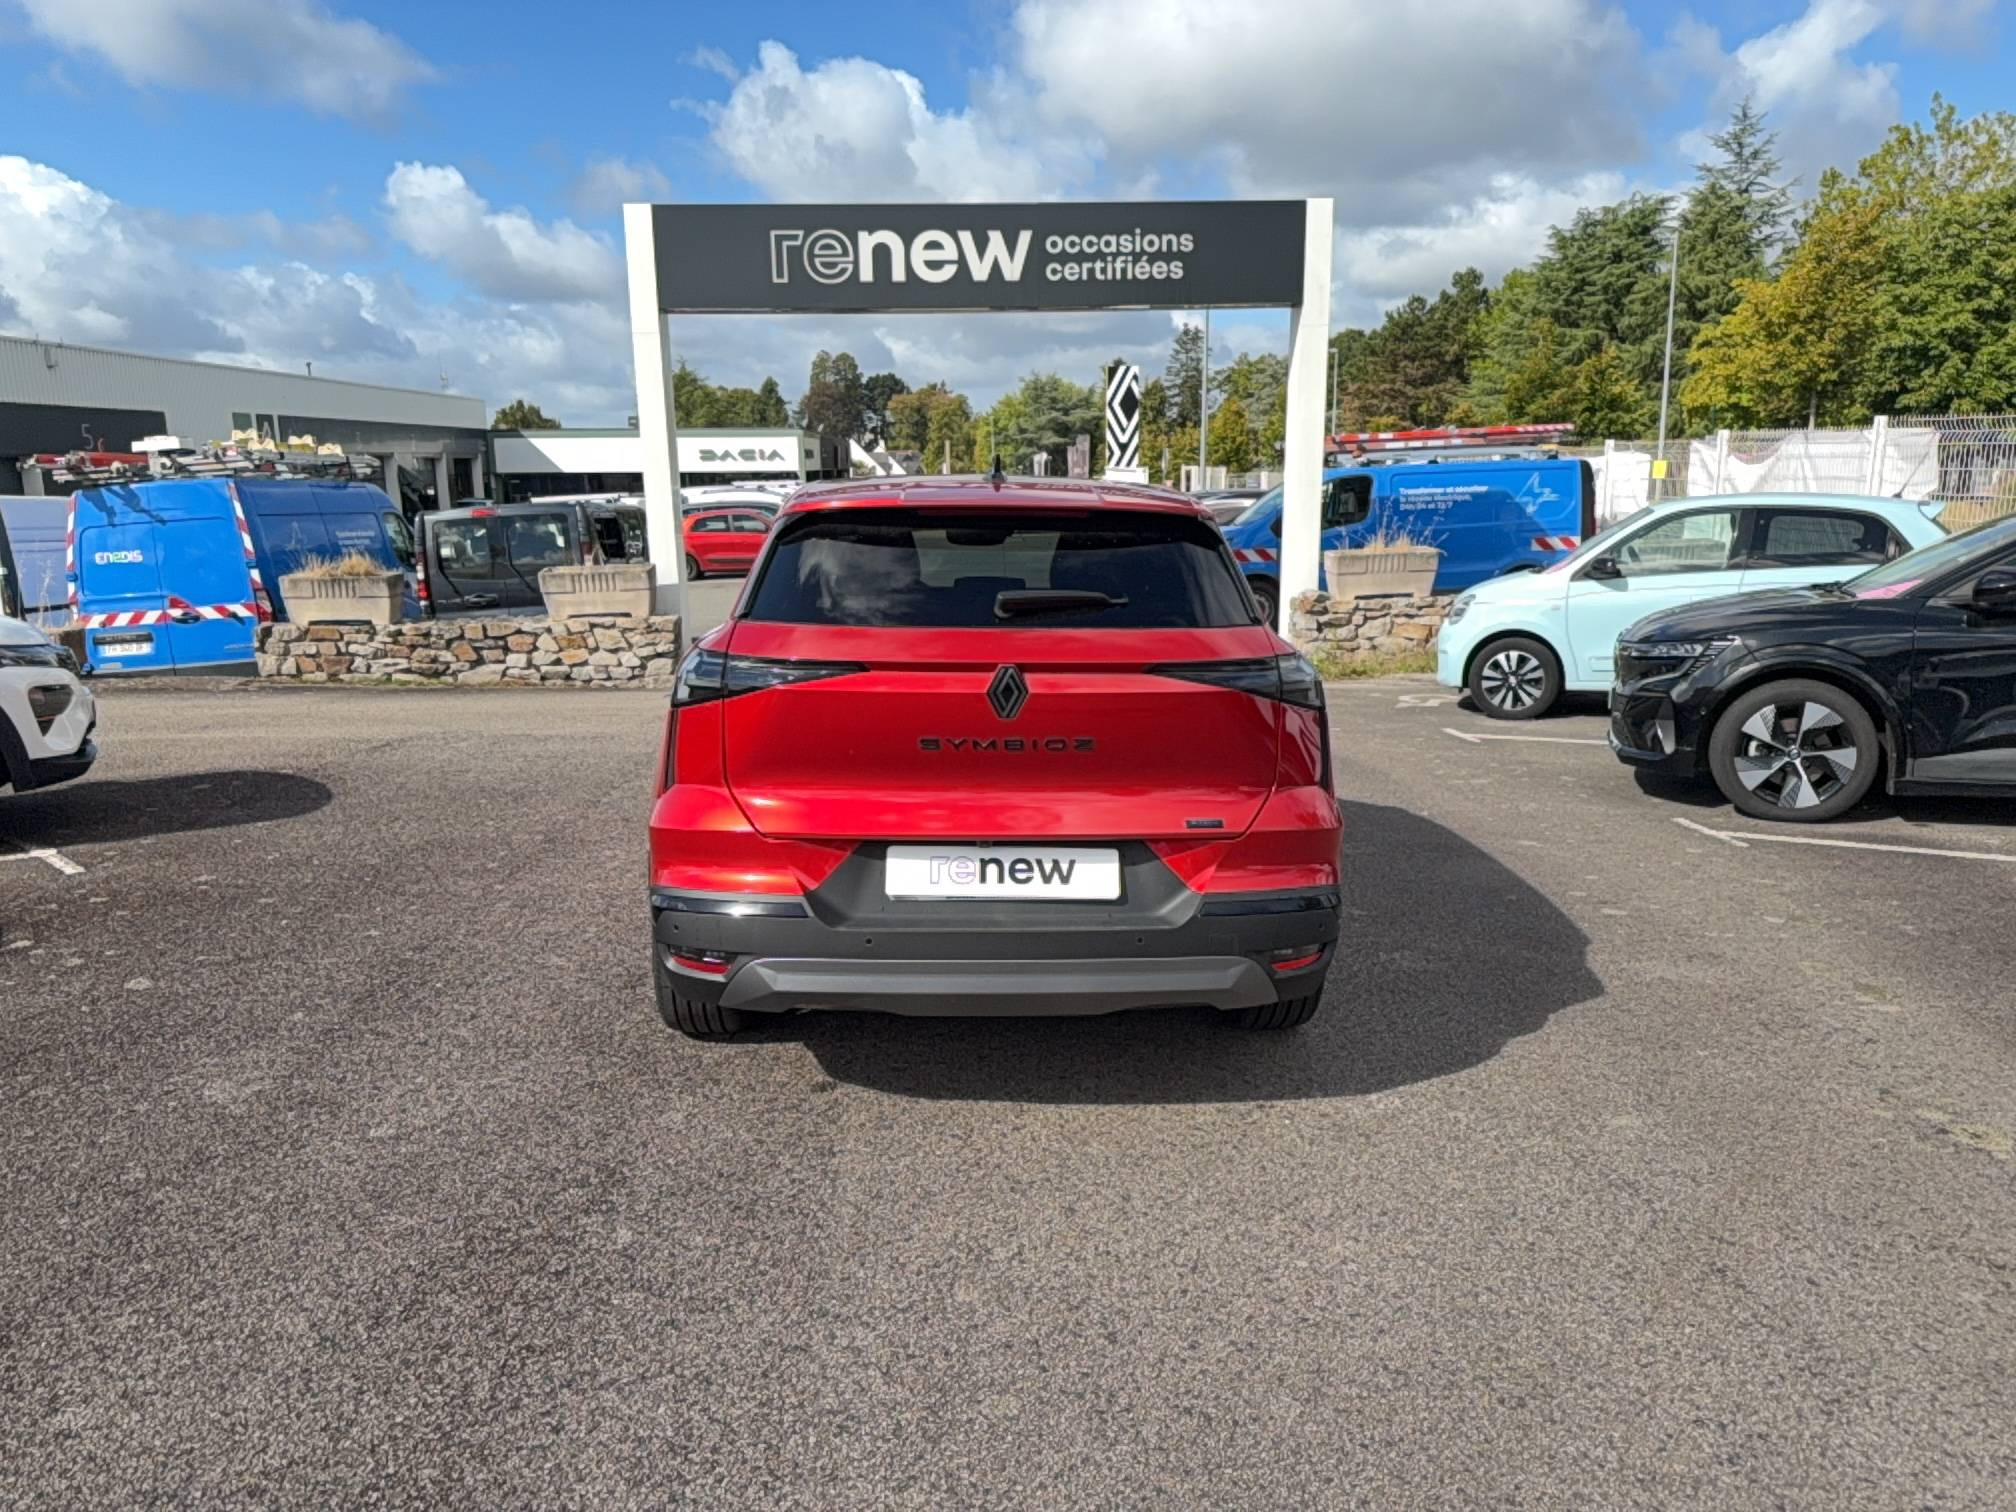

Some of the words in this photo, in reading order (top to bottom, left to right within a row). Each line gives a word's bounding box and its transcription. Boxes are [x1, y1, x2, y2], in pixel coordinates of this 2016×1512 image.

[1045, 228, 1195, 255] occasions
[769, 229, 1033, 284] renew
[1045, 255, 1185, 281] certifiées
[698, 448, 787, 462] DACIA
[919, 737, 1096, 751] SYMBIOZ
[929, 856, 1077, 886] renew
